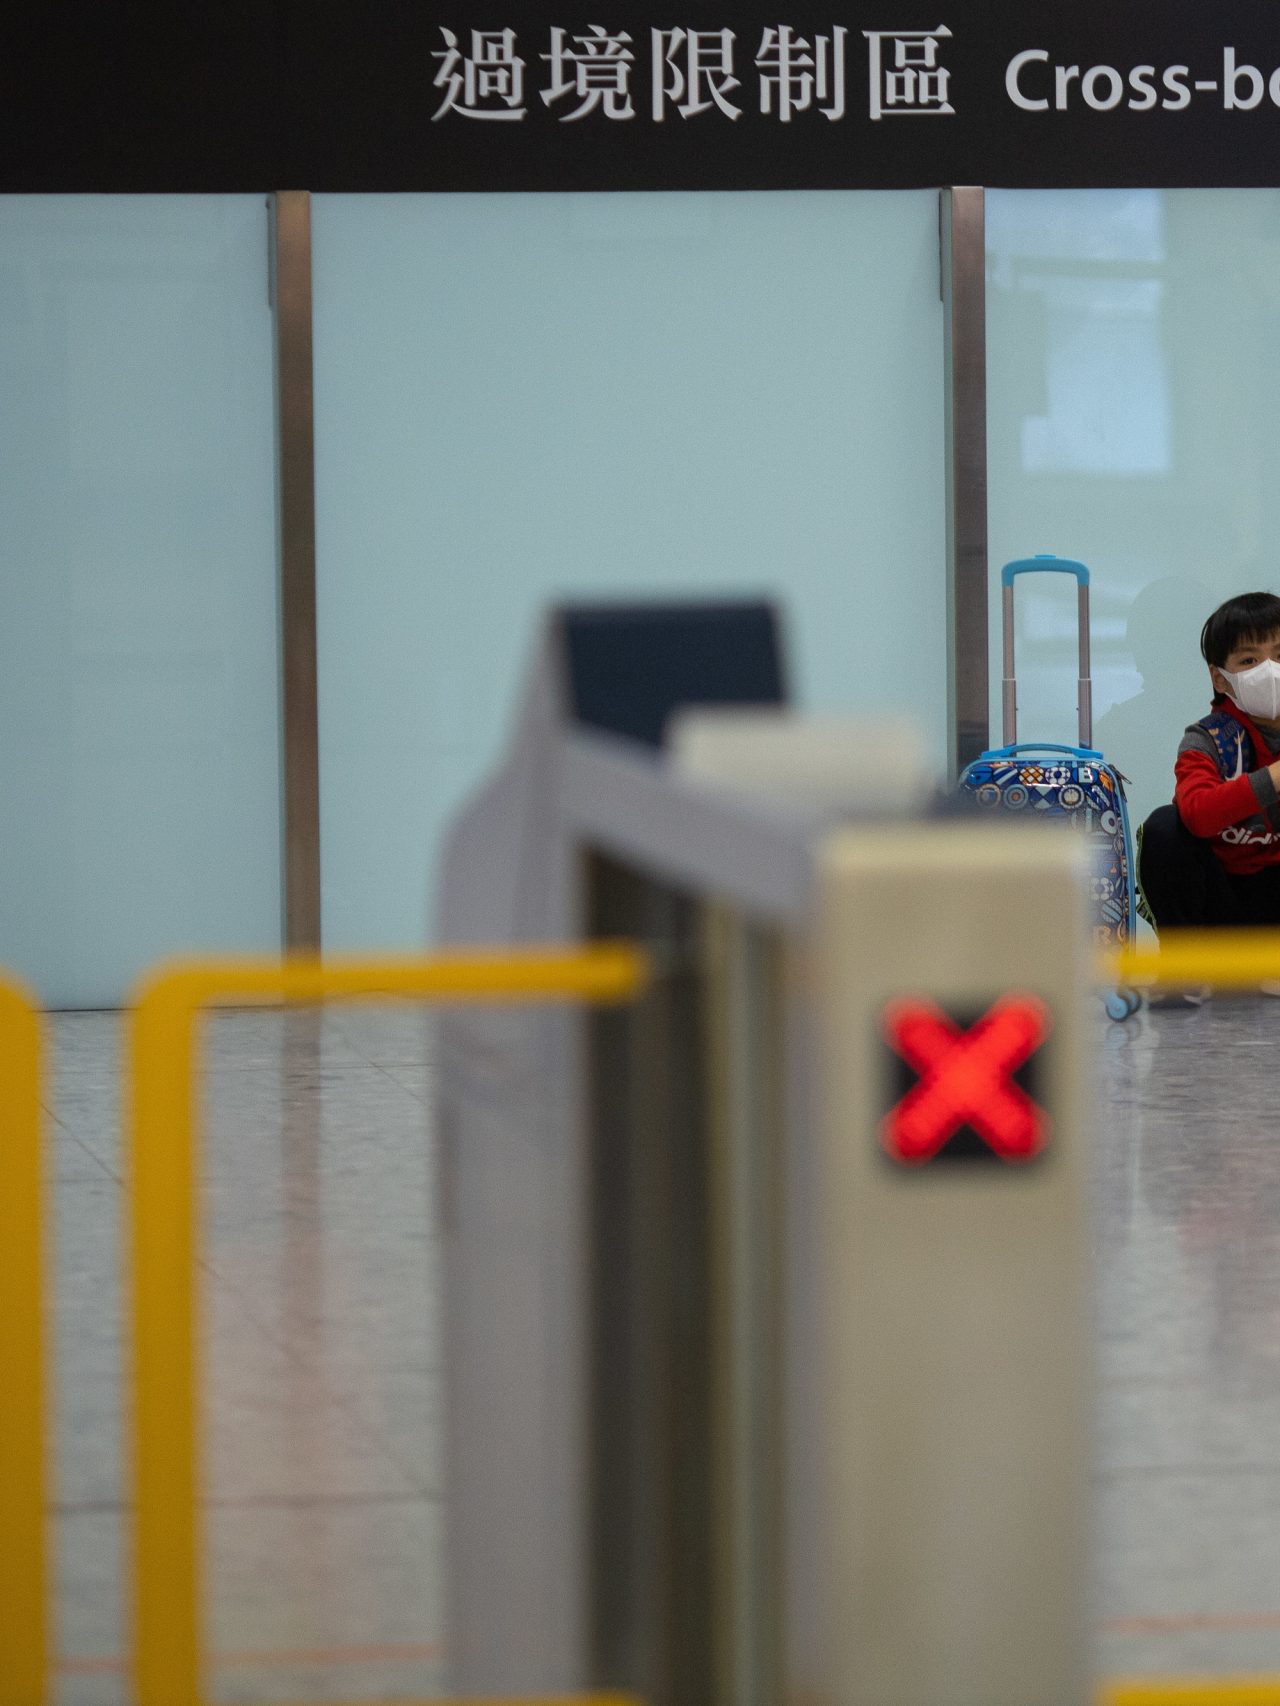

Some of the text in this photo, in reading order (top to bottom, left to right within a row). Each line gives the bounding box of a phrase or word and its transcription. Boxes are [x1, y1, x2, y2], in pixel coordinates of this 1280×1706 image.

[431, 24, 956, 120] 過境限制區
